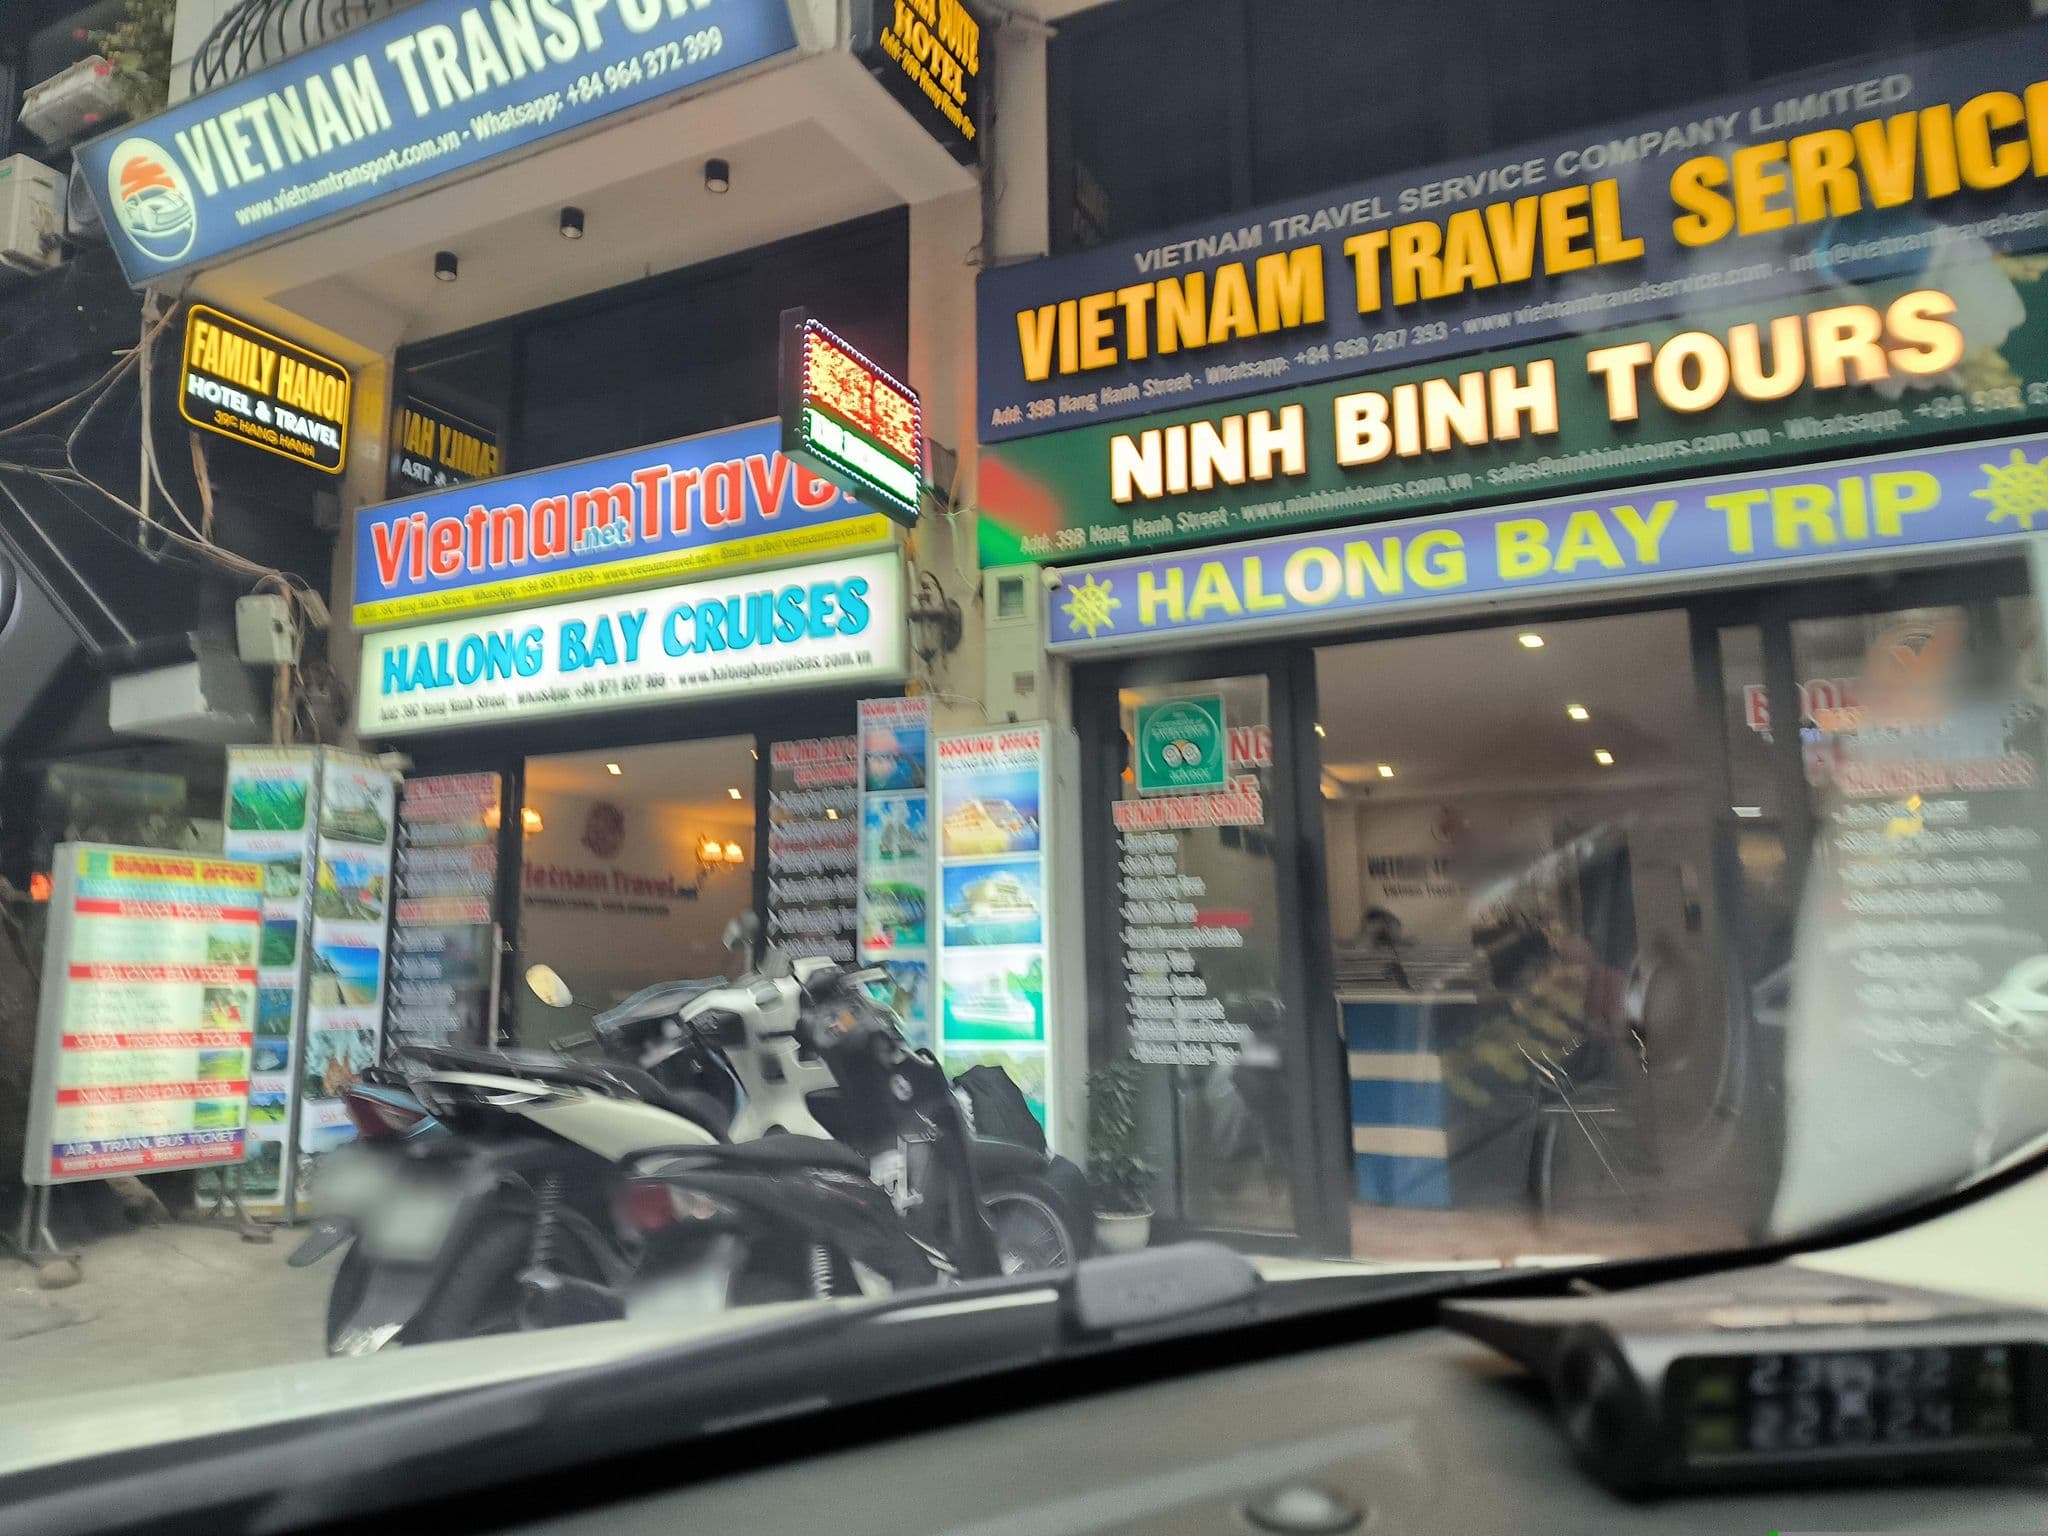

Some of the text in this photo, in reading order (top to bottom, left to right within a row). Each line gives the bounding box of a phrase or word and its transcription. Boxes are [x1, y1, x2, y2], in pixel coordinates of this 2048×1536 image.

[175, 55, 392, 198] VIETNAM
[235, 129, 460, 226] www.vietnamtransport.com.vn
[567, 72, 604, 107] +84
[604, 57, 642, 93] 964
[643, 42, 684, 79] 372
[683, 26, 722, 64] 399
[1134, 73, 1914, 274] VIETNAM TRAVEL SERVICE COMPANY LIMITED
[1016, 243, 1327, 383] VIETNAM
[1343, 177, 1646, 315] TRAVEL
[187, 373, 342, 450] HOTEL & TRAVEL
[190, 318, 347, 425] FAMILY HANOI
[1110, 288, 1965, 504] NINH BINH TOURS
[1137, 470, 1942, 626] HALONG BAY TRIP
[380, 574, 871, 696] HALONG BAY CRUISES
[193, 1082, 232, 1097] TOUR
[200, 1031, 242, 1047] TOUR
[153, 1134, 187, 1149] BUS
[188, 1130, 238, 1146] TICKET
